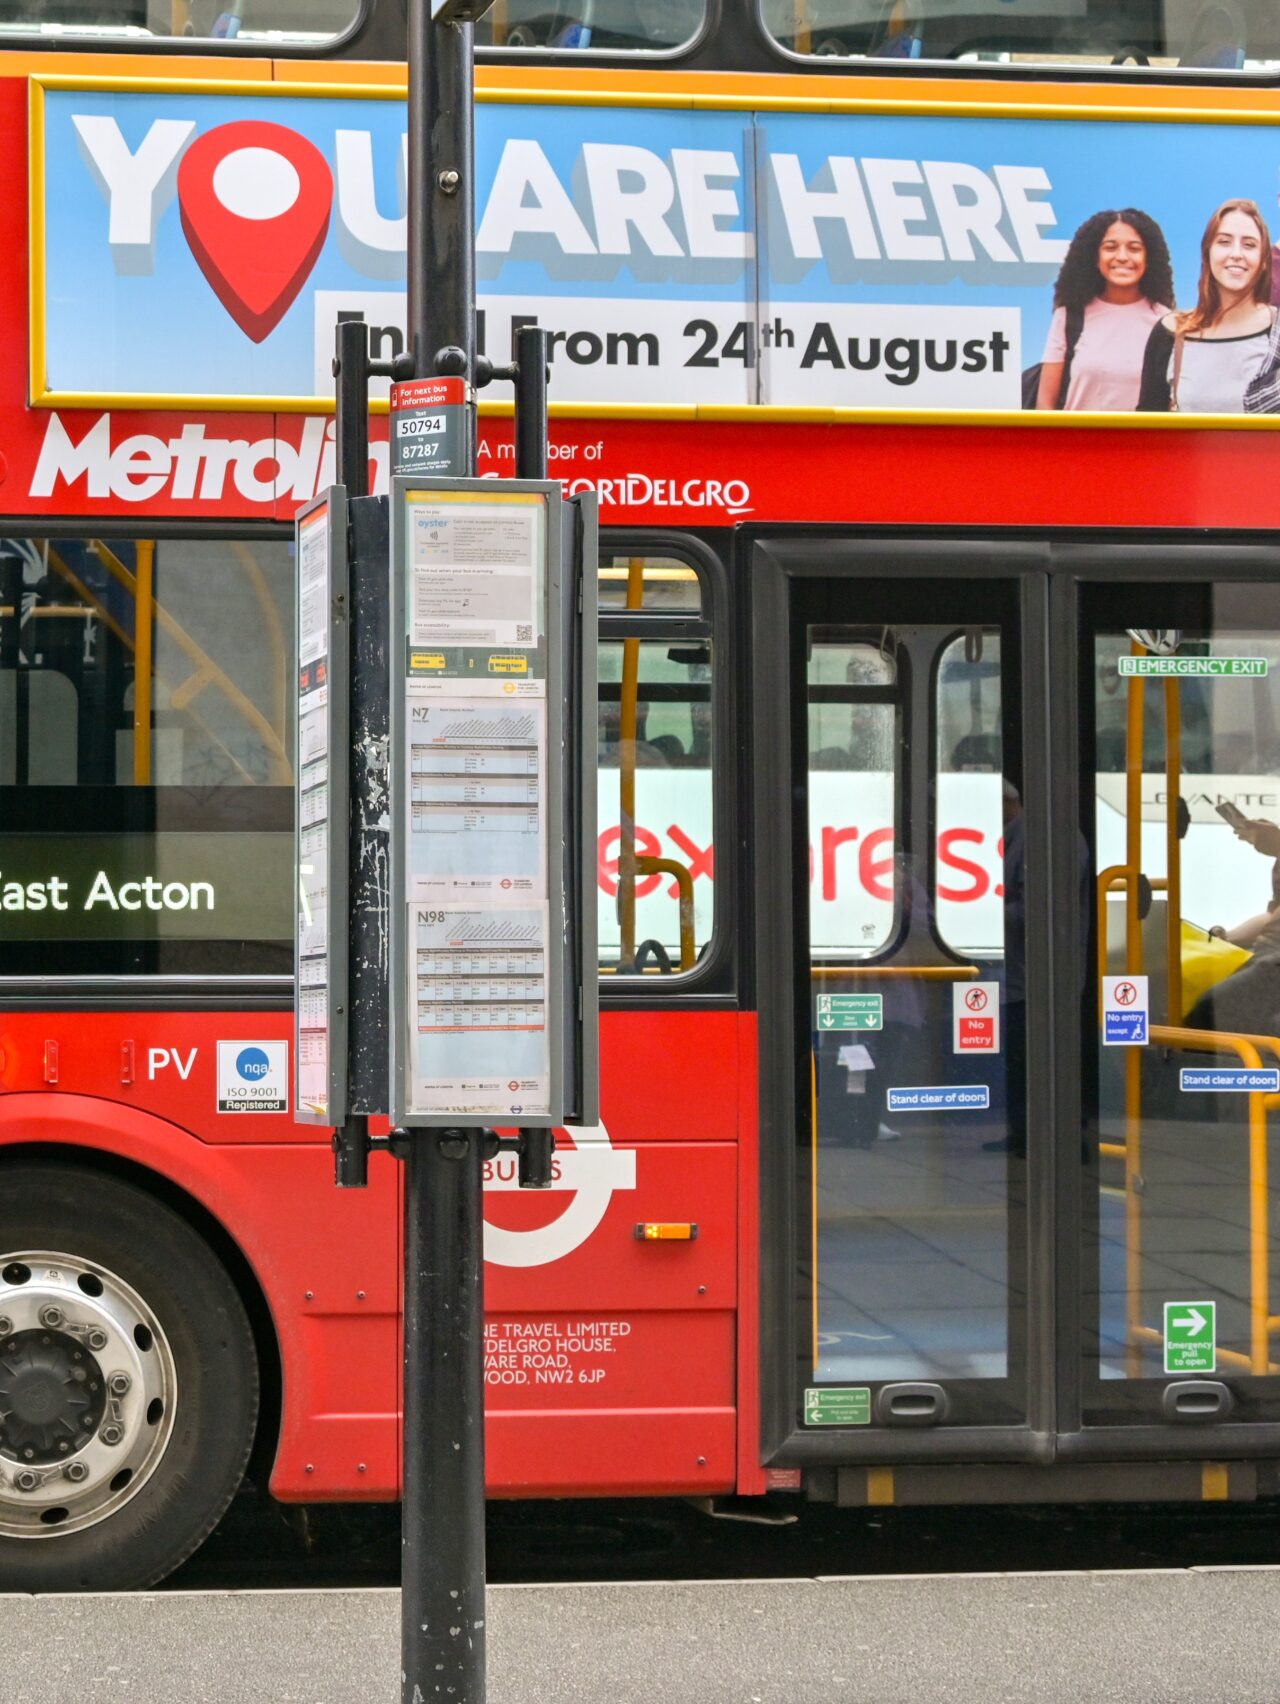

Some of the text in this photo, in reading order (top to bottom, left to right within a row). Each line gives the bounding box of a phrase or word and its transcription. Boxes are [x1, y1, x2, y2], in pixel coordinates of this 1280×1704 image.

[476, 138, 756, 284] ARE
[768, 152, 1072, 285] HERE
[799, 322, 1010, 386] August
[400, 389, 412, 397] For
[414, 387, 431, 395] next
[402, 395, 445, 406] information
[401, 418, 441, 435] 50794
[402, 443, 439, 459] 87287
[477, 440, 604, 460] A mber of
[417, 519, 449, 529] oyster
[1138, 661, 1264, 673] EMERGENCY EXIT
[412, 707, 429, 719] N7
[83, 870, 215, 911] Acton
[417, 910, 445, 923] N98
[1107, 1014, 1143, 1023] No entry
[968, 1021, 984, 1029] No
[961, 1036, 992, 1045] entry
[148, 1048, 199, 1080] PV
[1183, 1075, 1277, 1085] Stand clear of doors
[227, 1087, 278, 1097] ISO 9001
[890, 1093, 986, 1104] Stand clear of doors
[226, 1100, 280, 1111] Registered
[483, 1160, 562, 1182] BUS
[503, 1323, 562, 1337] TRAVEL
[567, 1322, 631, 1336] LIMITED
[556, 1338, 617, 1353] HOUSE,
[1167, 1341, 1212, 1350] Emergency
[1182, 1349, 1198, 1359] pull
[522, 1354, 572, 1369] ROAD,
[1174, 1358, 1207, 1367] to open
[536, 1370, 573, 1384] NW2
[578, 1369, 606, 1384] 6JP
